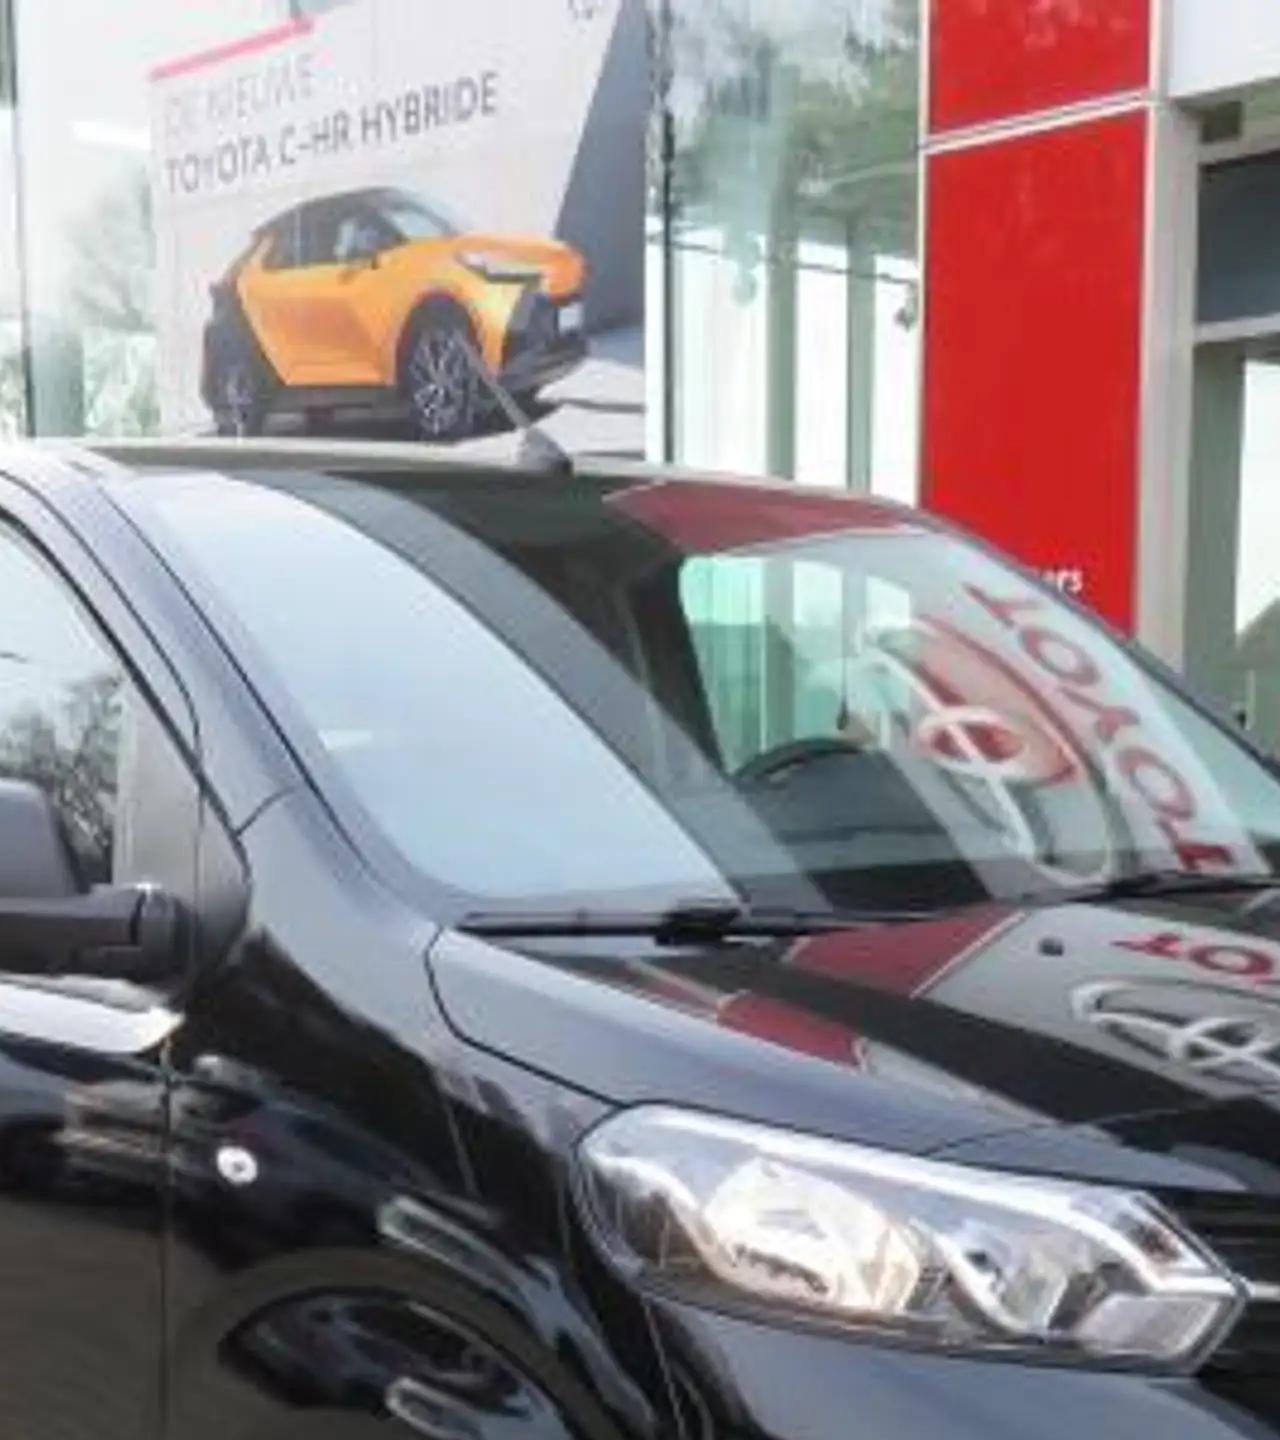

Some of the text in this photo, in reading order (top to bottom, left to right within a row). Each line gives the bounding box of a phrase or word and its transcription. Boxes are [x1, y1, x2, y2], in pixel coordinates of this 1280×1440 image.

[165, 70, 499, 194] TOYOTA C-HR HYBRIDE
